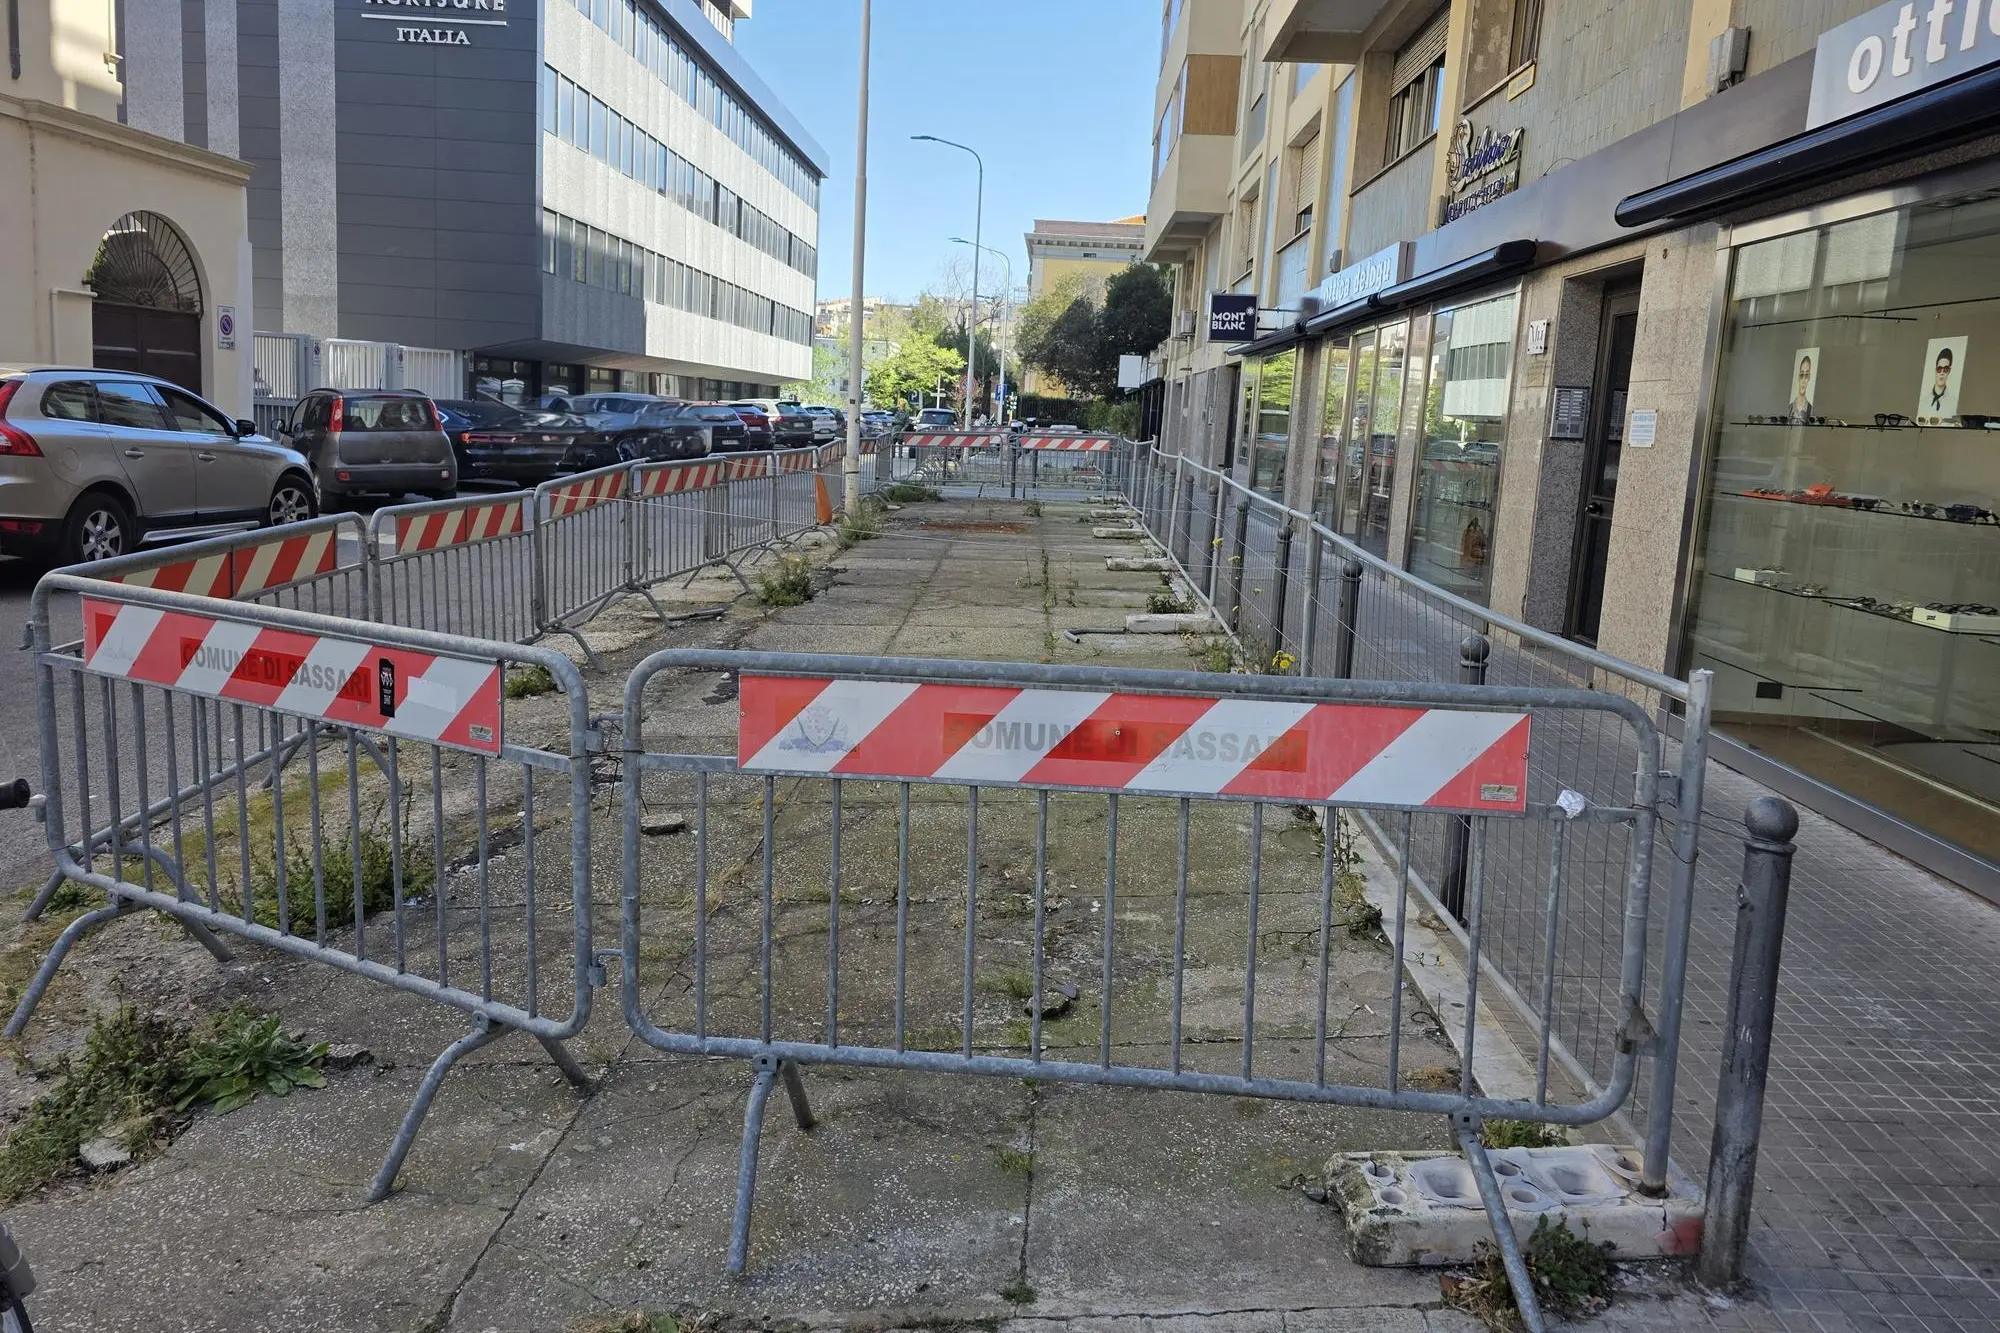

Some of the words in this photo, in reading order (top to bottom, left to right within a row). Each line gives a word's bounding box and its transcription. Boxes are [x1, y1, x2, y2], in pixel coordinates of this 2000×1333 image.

[396, 27, 471, 45] ITALIA
[1847, 0, 2000, 94] otti
[1212, 312, 1246, 321] MONT
[1212, 321, 1246, 330] BLANC
[182, 644, 259, 678] COMUNE
[263, 655, 281, 682] DI
[287, 659, 367, 697] SASSARI
